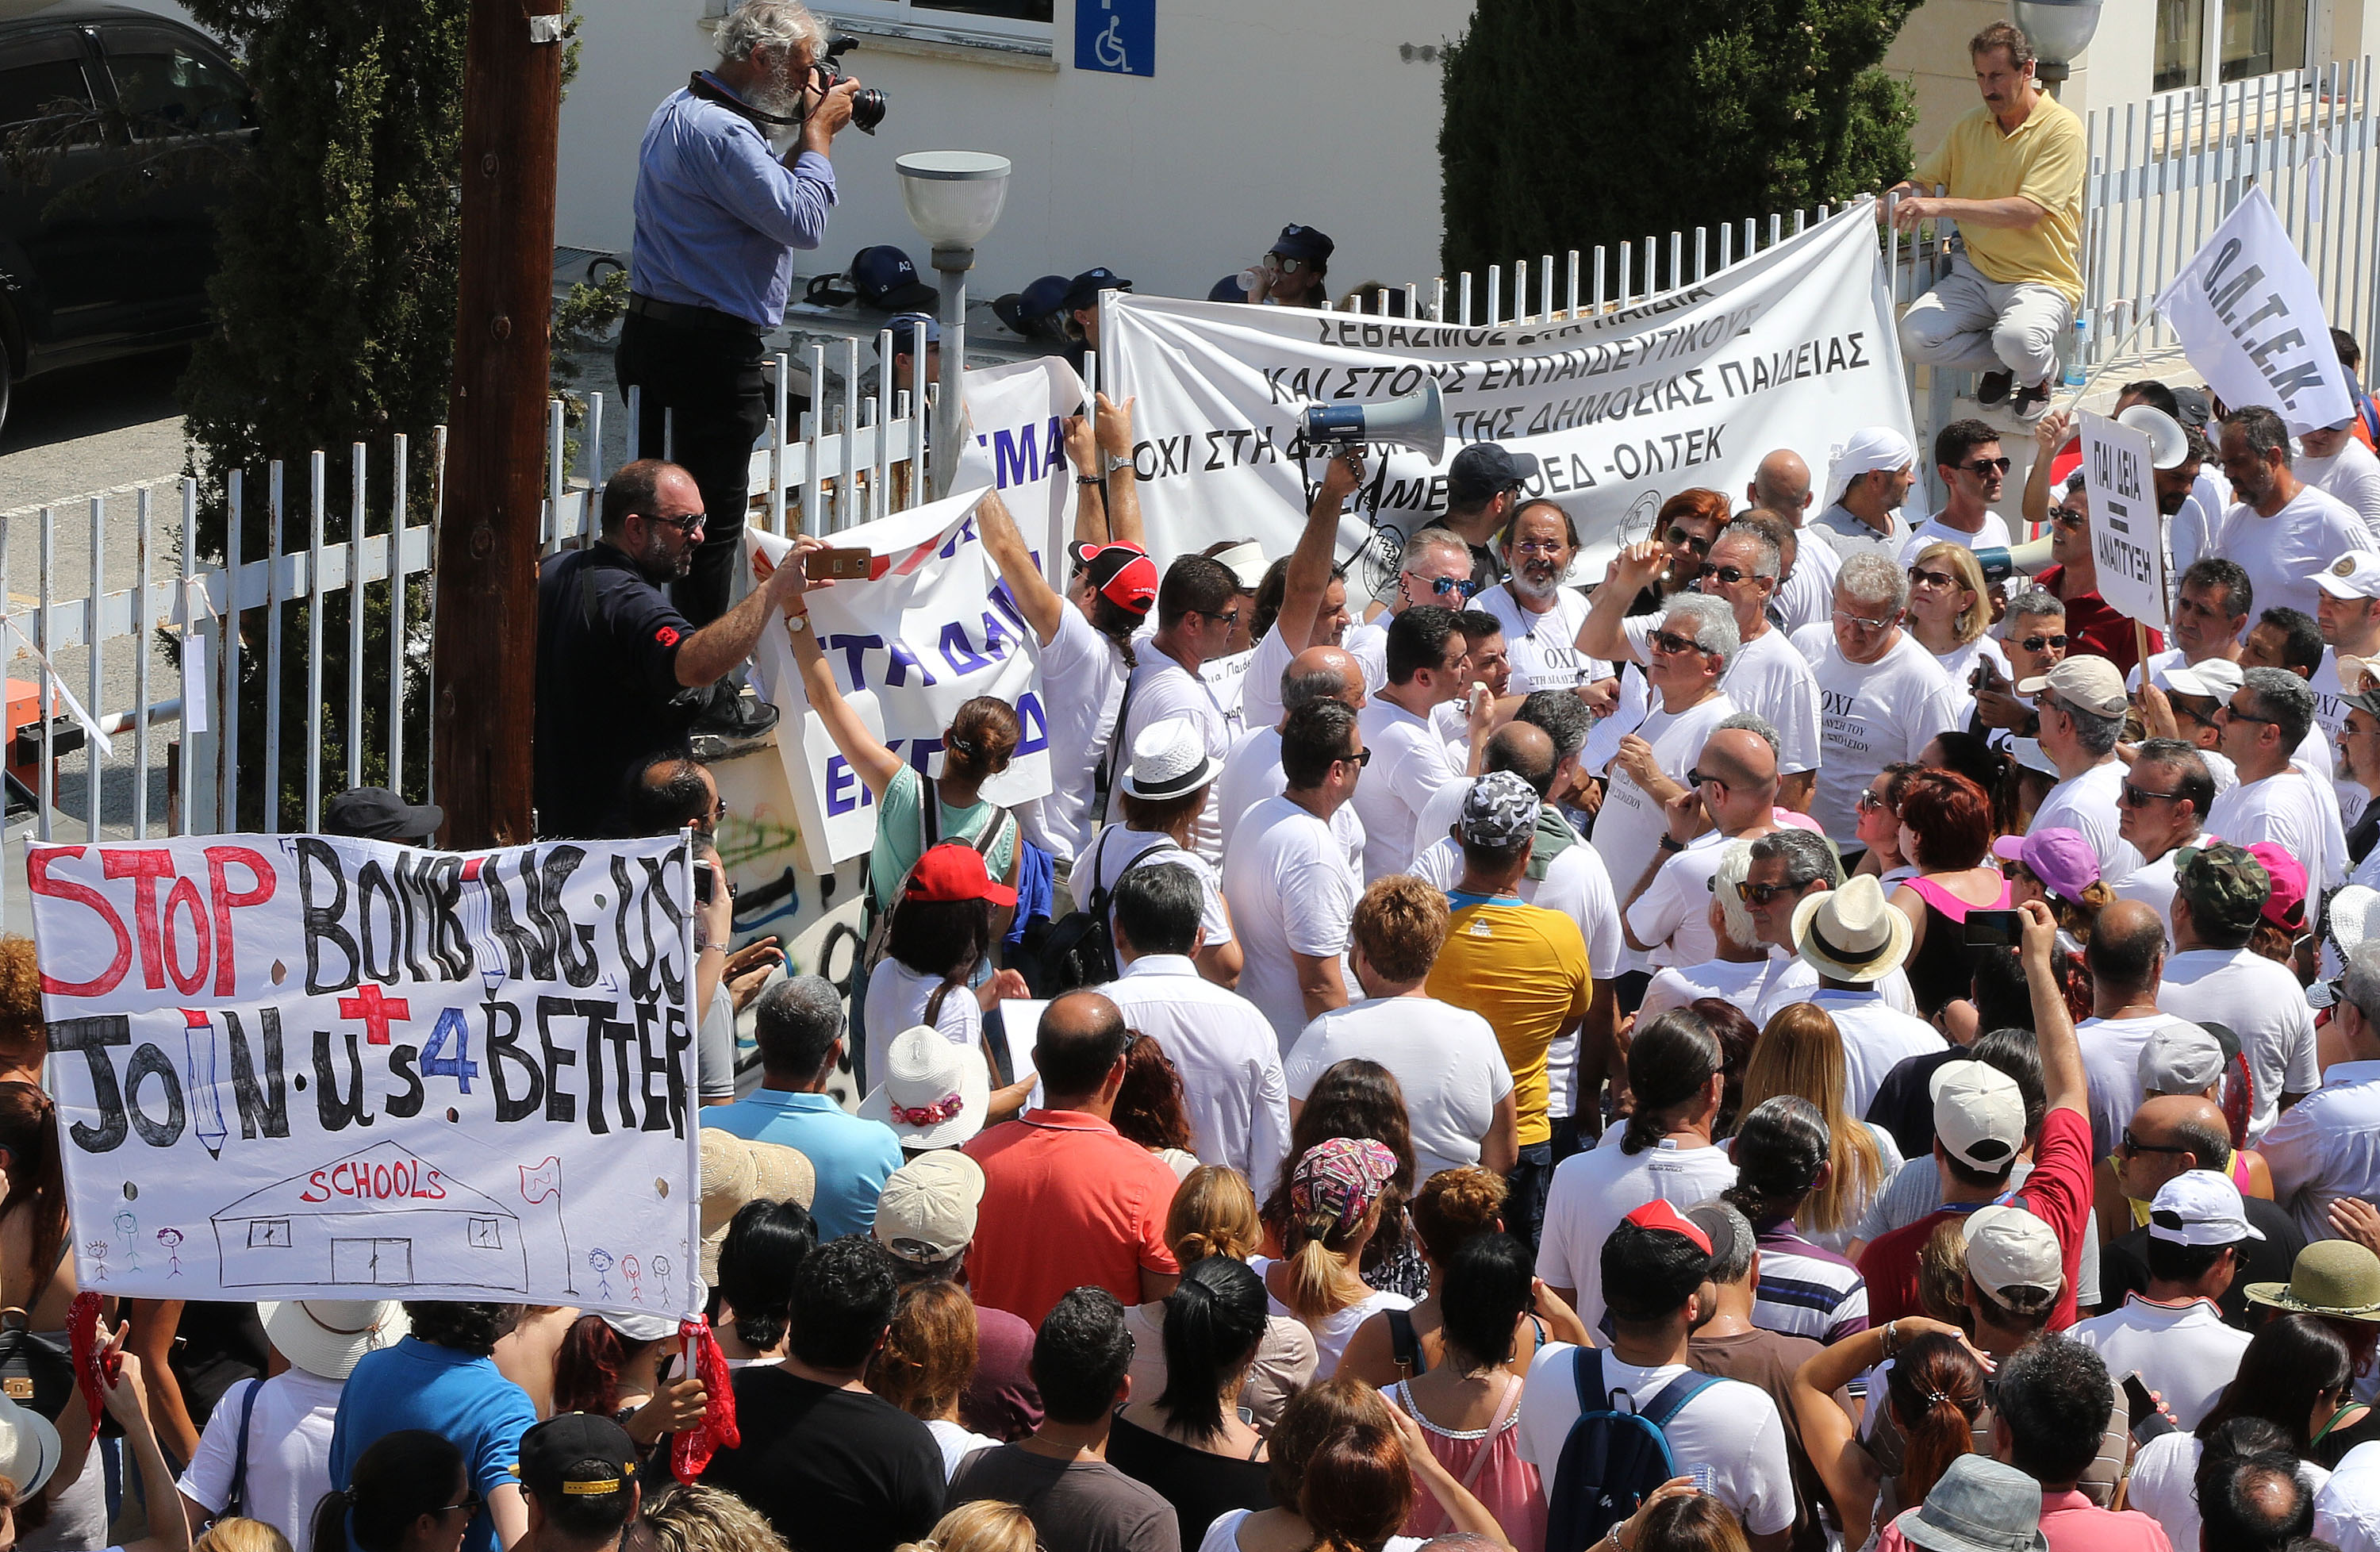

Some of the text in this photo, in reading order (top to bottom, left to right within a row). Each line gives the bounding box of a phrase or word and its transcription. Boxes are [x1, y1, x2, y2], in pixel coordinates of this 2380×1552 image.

[898, 260, 912, 273] A2
[1264, 303, 1761, 405] ΚΑΙ ΣΤΟΥΣ ΕΚΠΑΙΔΕΥΤΙΚΟΥΣ
[1132, 434, 1192, 481] ΟΧΙ
[1204, 425, 1276, 471] ΣΤΗ
[1453, 406, 1525, 445] ΤΗΣ
[1527, 370, 1714, 436] ΔΗΜΟΣΙΑΣ
[1718, 331, 1870, 398] ΠΑΙΔΕΙΑΣ
[977, 415, 1068, 490] ΜΑ
[2098, 530, 2152, 586] ΑΝΑΠΤΥΞΗ
[1544, 647, 1578, 669] ΟΧΙ
[1822, 718, 1866, 736] ΛΥΣΗ ΤΟΥ
[28, 845, 278, 997] STOP
[610, 847, 687, 1005] US
[48, 1008, 290, 1160] JOIN
[419, 1008, 479, 1095] 4
[479, 995, 693, 1140] BETTER
[300, 1159, 447, 1203] SCHOOLS
